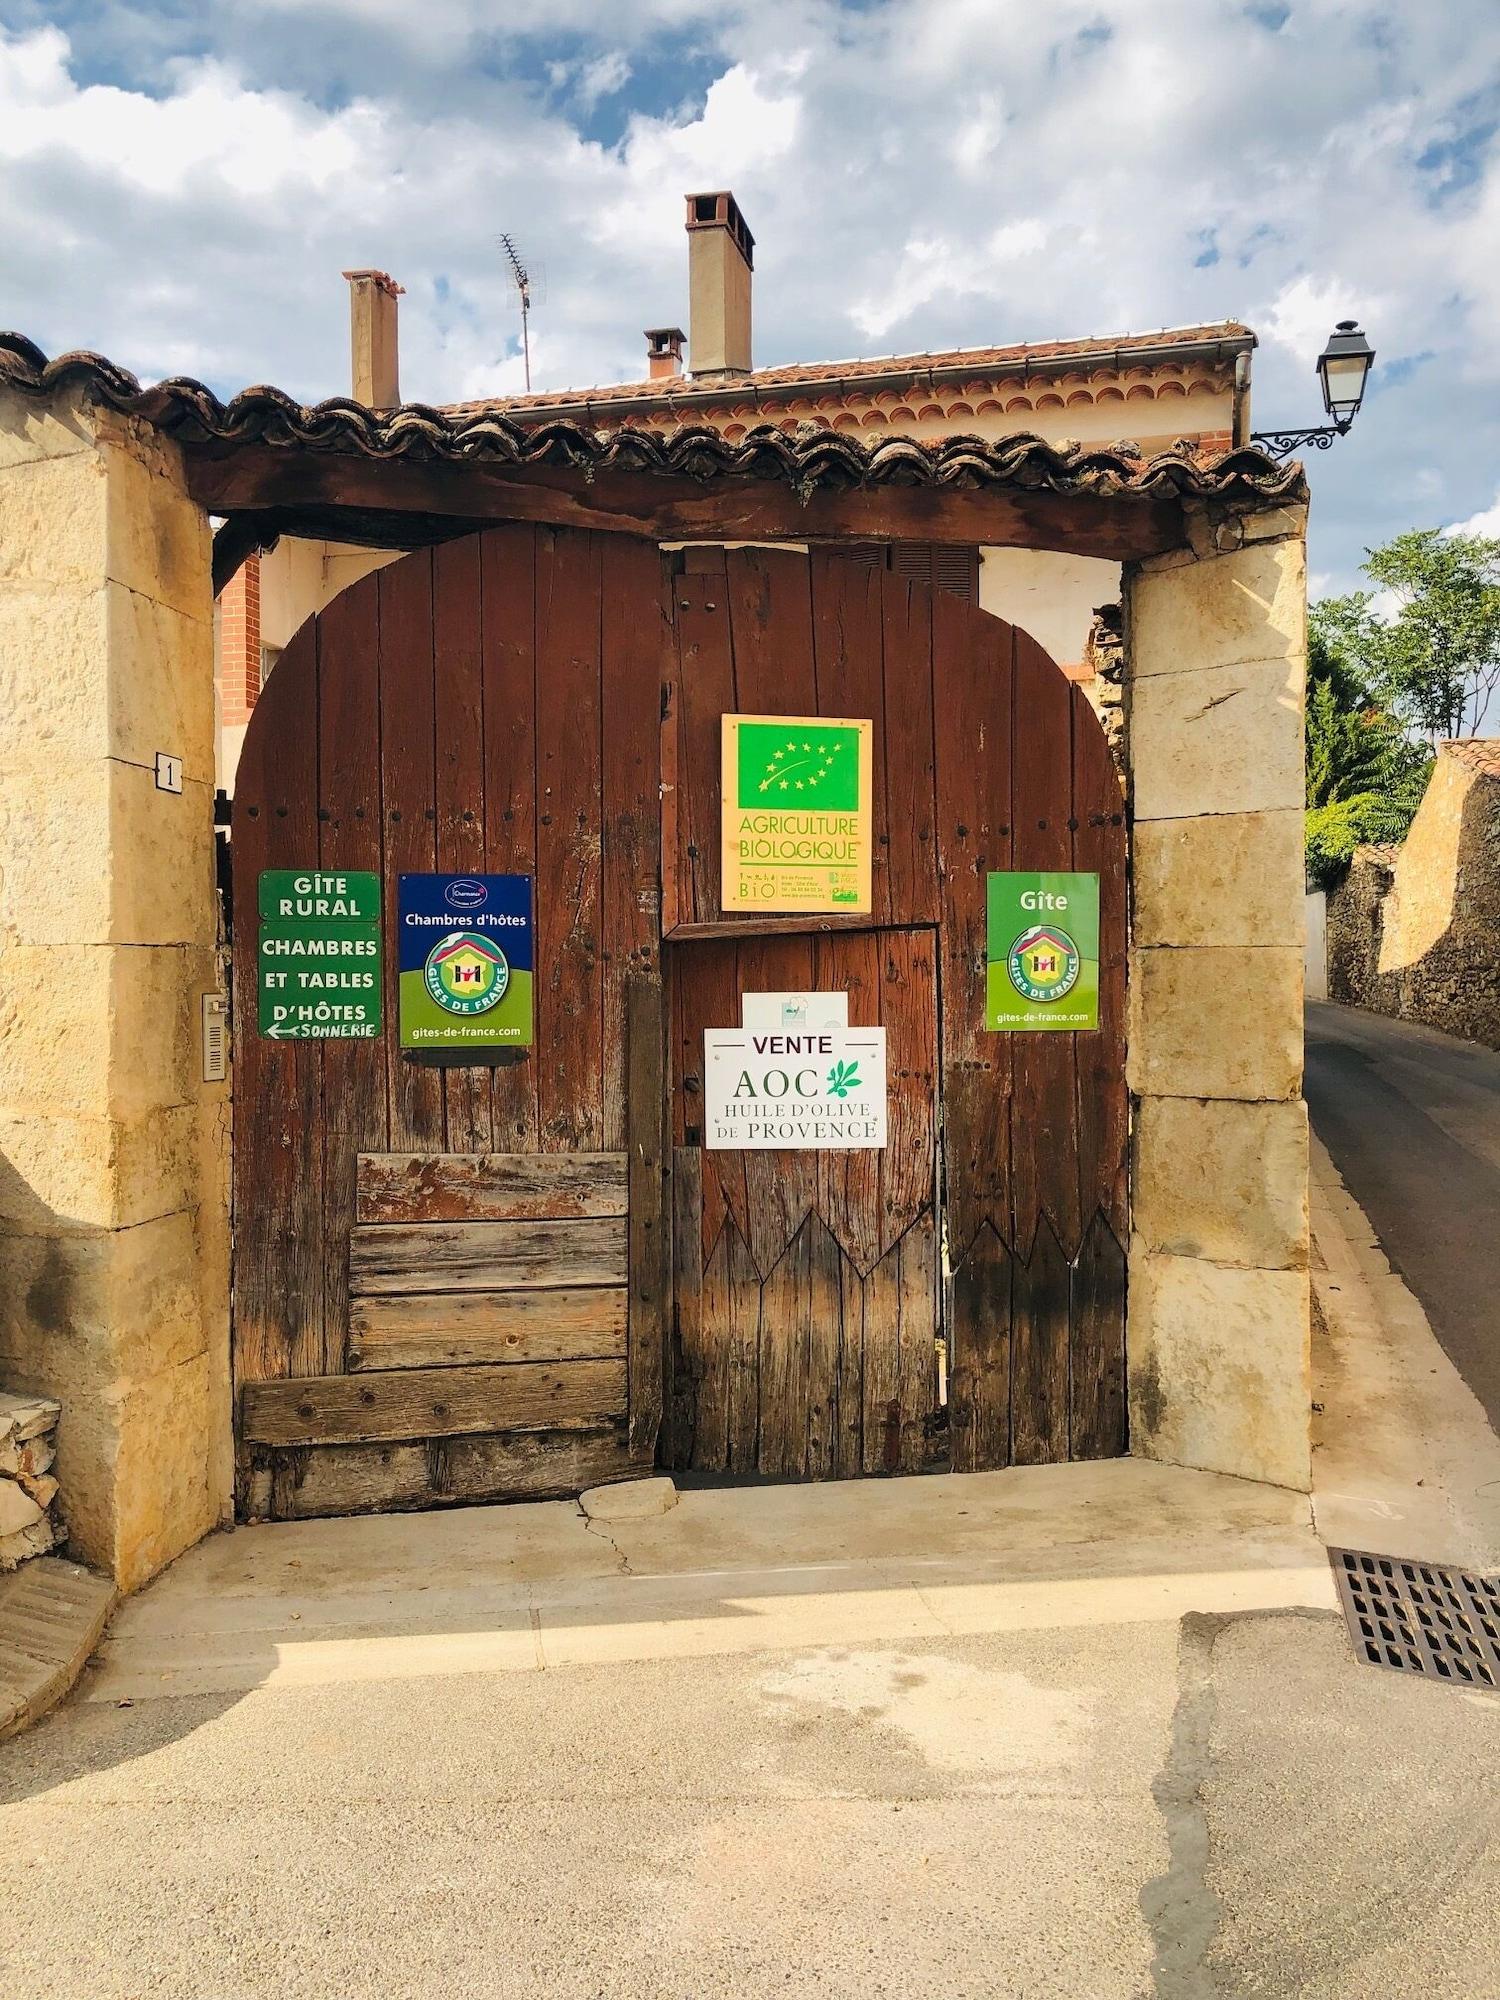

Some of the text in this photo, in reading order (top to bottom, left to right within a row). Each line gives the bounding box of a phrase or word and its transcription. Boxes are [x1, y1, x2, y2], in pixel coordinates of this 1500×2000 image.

[167, 762, 173, 786] 1
[739, 815, 859, 836] AGRICULTURE
[739, 840, 857, 860] BIOLOGIQUE
[294, 874, 347, 894] GÎTE
[279, 899, 361, 916] RURAL
[1020, 891, 1069, 910] Gîte
[405, 913, 527, 927] Chambres d'hôtes
[262, 939, 377, 956] CHAMBRES
[265, 972, 374, 988] ET TABLES
[1030, 988, 1046, 999] DE
[1050, 957, 1077, 998] FRANCE
[451, 1001, 470, 1012] DE
[474, 967, 506, 1010] FRANCE
[273, 1001, 366, 1021] D'HÔTES
[997, 1013, 1088, 1024] gites-de-france.com
[412, 1027, 521, 1040] gites-de-france.com
[752, 1036, 833, 1054] VENTE
[733, 1069, 818, 1098] AOC
[724, 1103, 870, 1118] HUILE D'OLIVE
[717, 1121, 878, 1139] DE PROVENCE
